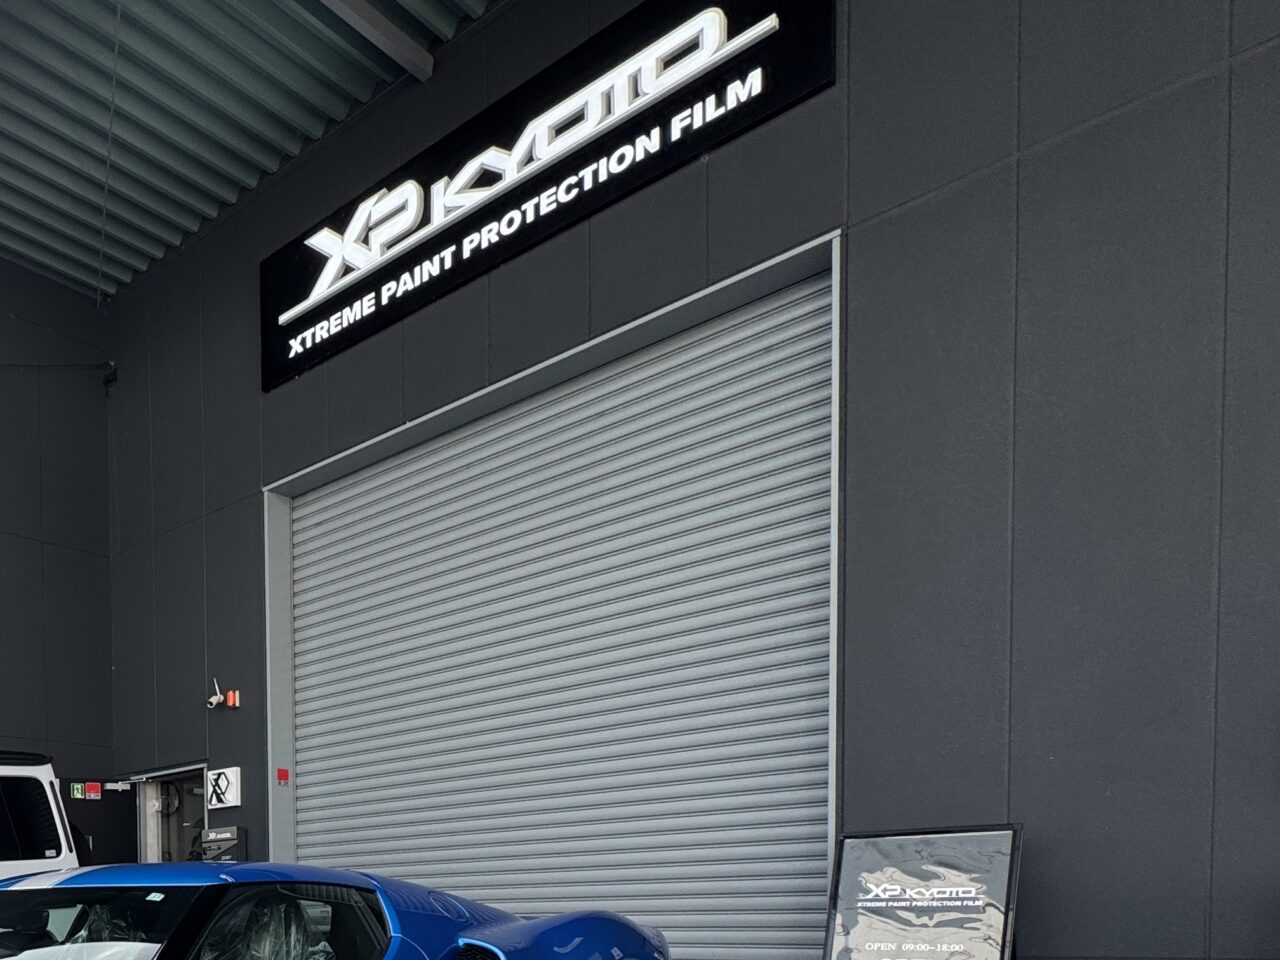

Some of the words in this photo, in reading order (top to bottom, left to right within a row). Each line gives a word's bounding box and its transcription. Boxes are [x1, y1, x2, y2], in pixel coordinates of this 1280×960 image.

[431, 7, 728, 227] KYOTO
[287, 292, 376, 359] XTREME
[381, 245, 456, 306] PAINT
[462, 126, 661, 259] PROTECTION
[670, 67, 762, 143] FILM
[865, 943, 896, 951] OPEN
[905, 887, 977, 898] KYOTO
